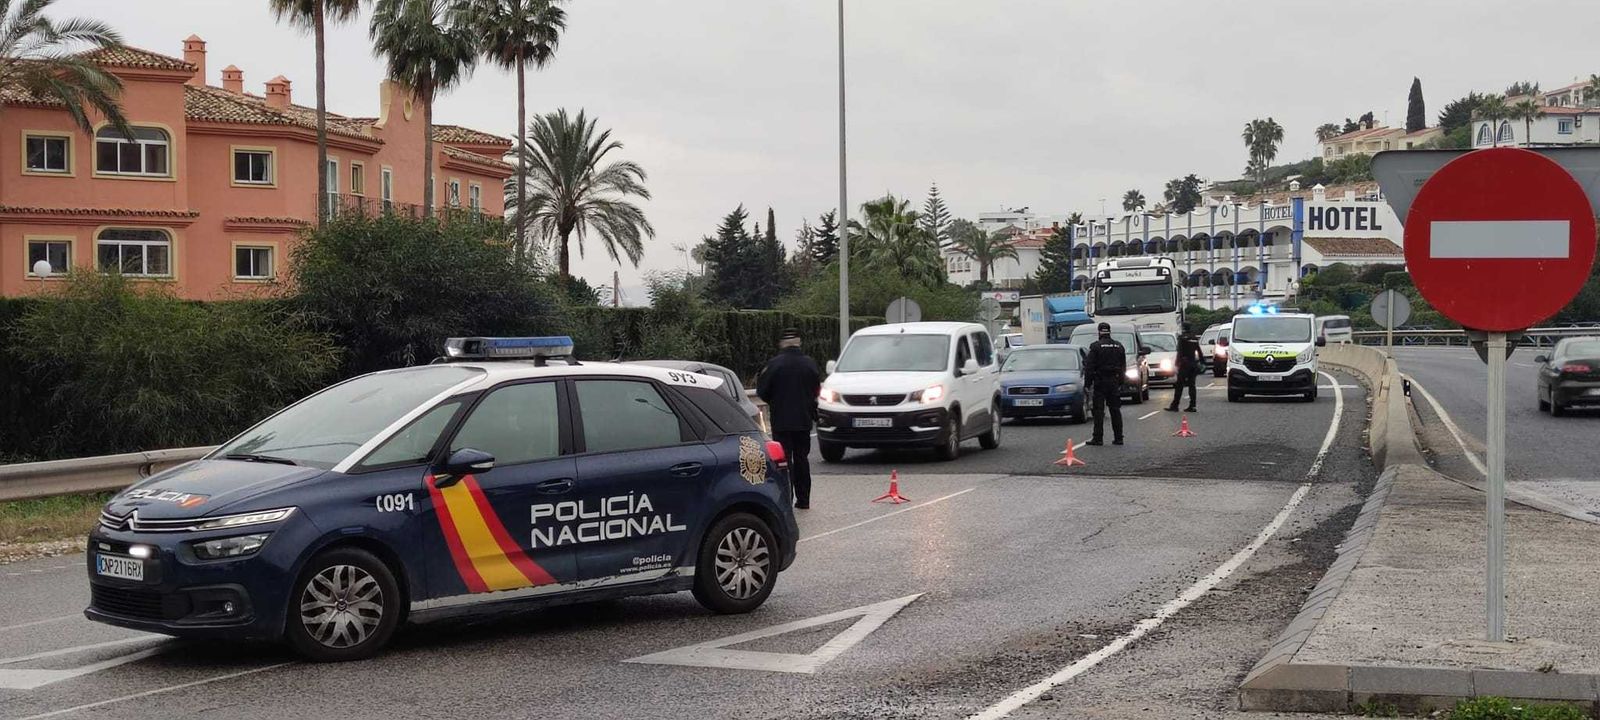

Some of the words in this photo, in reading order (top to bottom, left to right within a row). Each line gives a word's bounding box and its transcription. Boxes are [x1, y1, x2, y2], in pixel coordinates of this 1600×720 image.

[1264, 205, 1293, 220] HOTEL
[1308, 206, 1382, 231] HOTEL
[667, 367, 698, 386] 9Y3
[383, 493, 414, 512] 091
[530, 490, 653, 524] POLICÍA
[530, 513, 687, 548] NACIONAL
[101, 557, 142, 578] CNP2116RX
